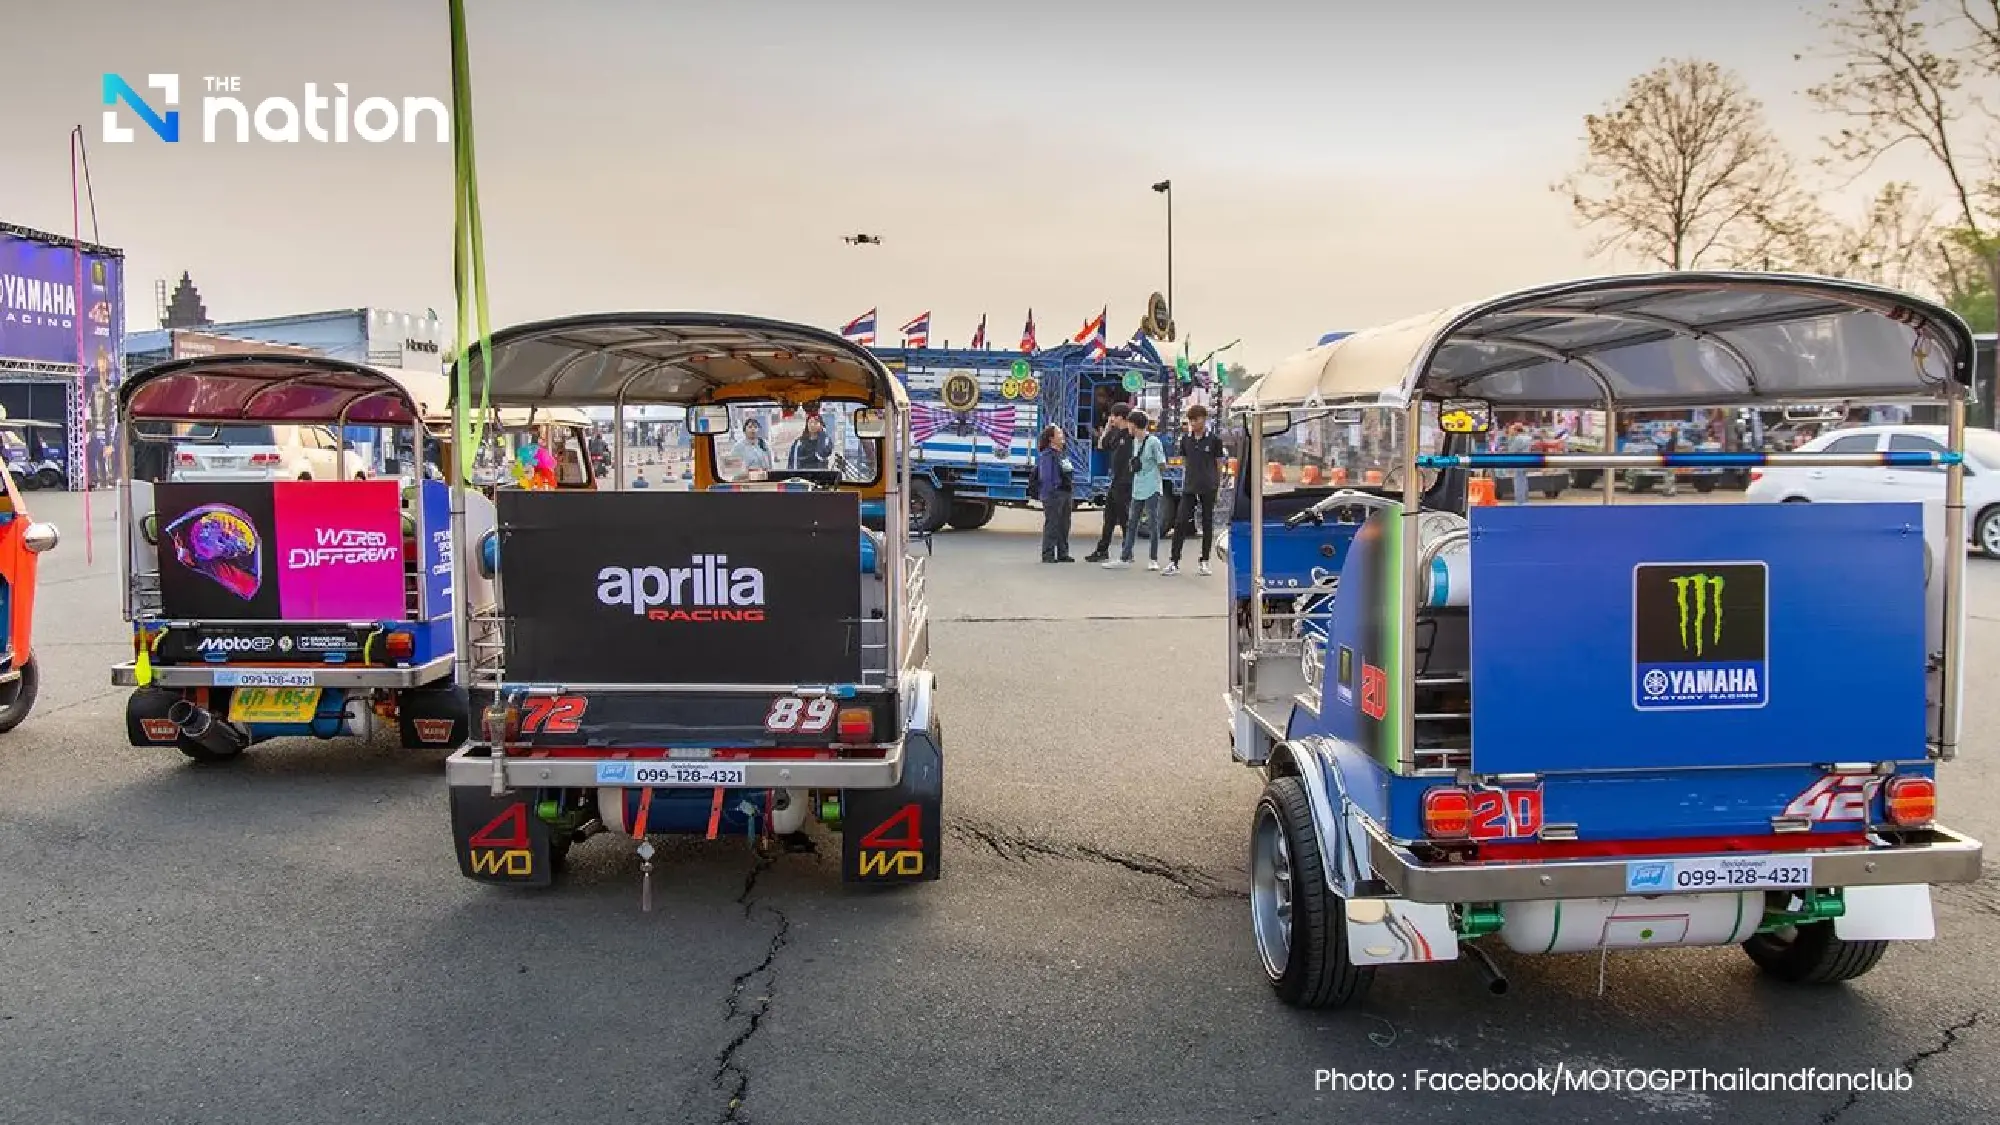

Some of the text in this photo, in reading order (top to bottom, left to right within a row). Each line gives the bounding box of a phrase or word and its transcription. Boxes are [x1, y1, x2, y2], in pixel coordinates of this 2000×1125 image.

[4, 273, 76, 316] YAMAHA
[315, 528, 387, 546] WIRED
[288, 547, 398, 569] DIFFERENT
[597, 554, 765, 615] aprilia
[649, 610, 764, 621] RACING
[197, 636, 275, 651] MotoGP
[1668, 669, 1758, 693] YAMAHA
[521, 697, 588, 733] 72
[765, 696, 838, 733] 89
[637, 768, 742, 783] 099-128-4321
[469, 803, 530, 848] 4
[860, 805, 923, 848] 4
[1678, 867, 1808, 886] 099-128-4321
